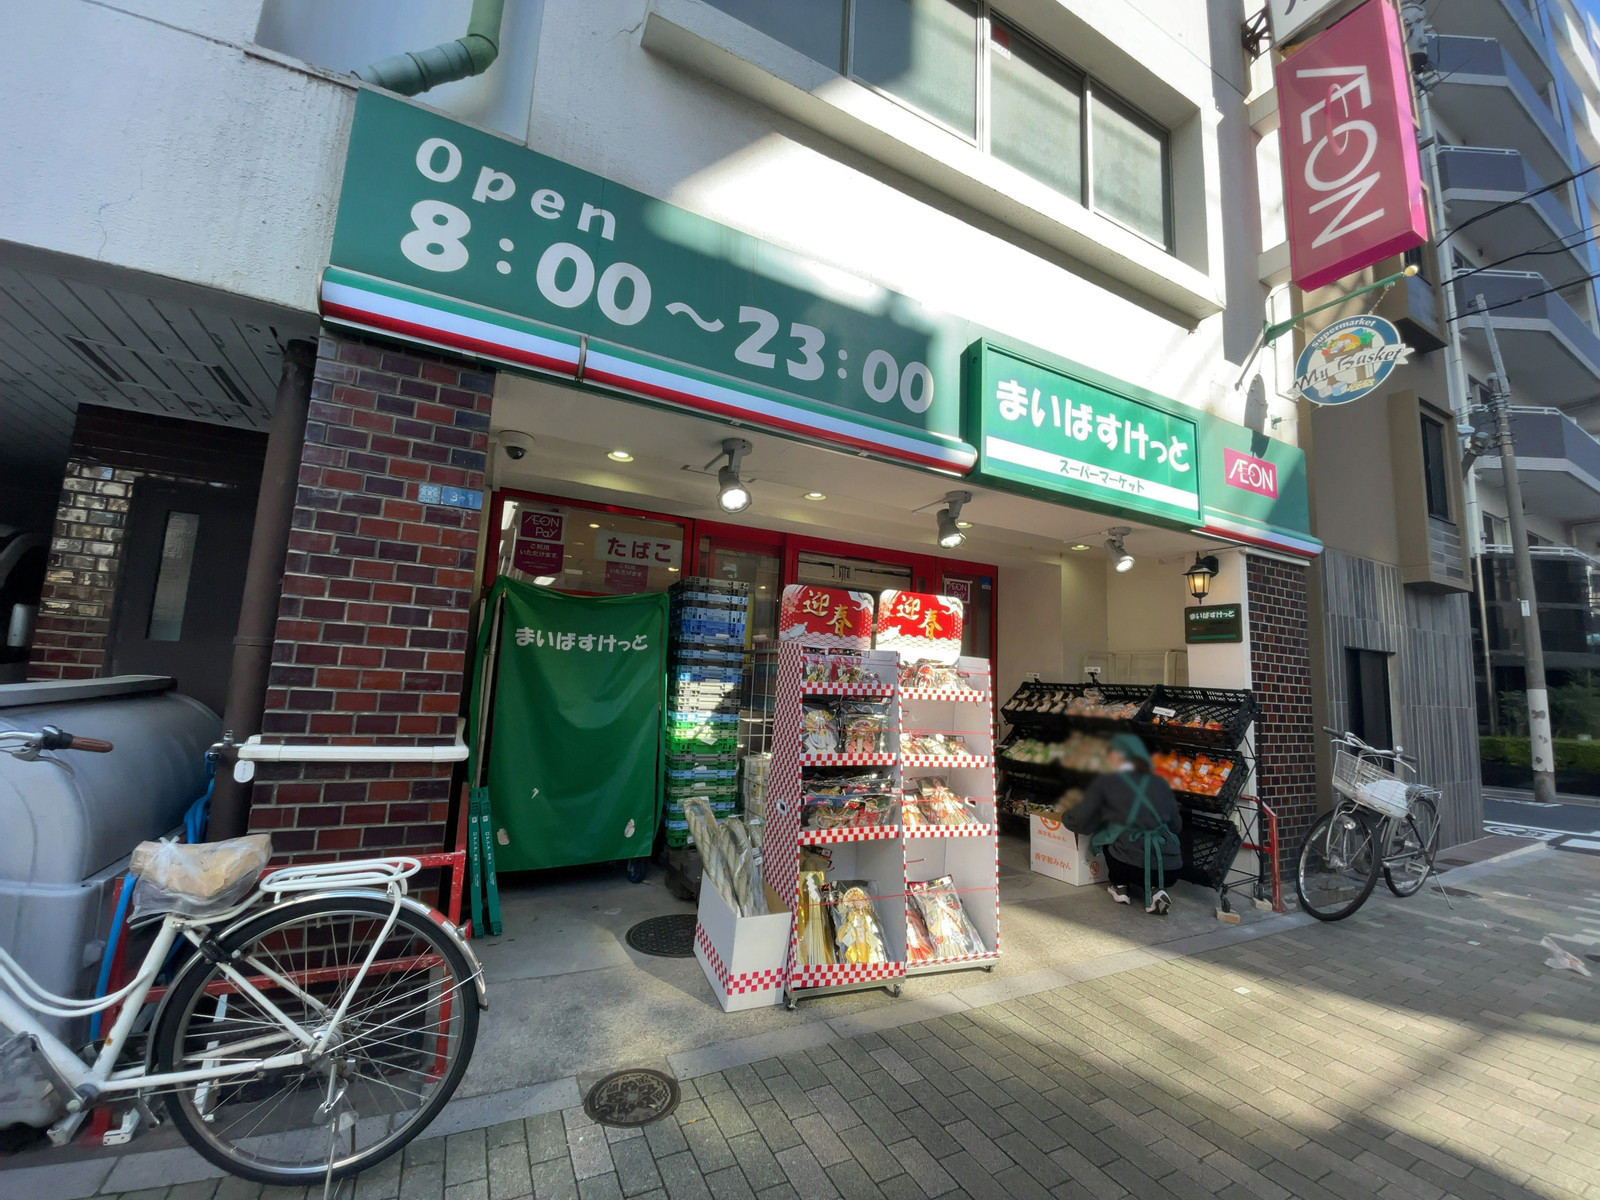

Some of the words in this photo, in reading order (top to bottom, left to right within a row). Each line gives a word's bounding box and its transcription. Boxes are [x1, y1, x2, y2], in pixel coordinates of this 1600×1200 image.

[415, 137, 617, 241] Open
[1311, 318, 1376, 348] Supermarket
[1293, 366, 1329, 390] My
[1337, 345, 1403, 370] Basket
[996, 380, 1191, 472] まいばすけっと
[1060, 459, 1145, 494] スーパーマーケット
[535, 526, 558, 538] Pay
[607, 537, 671, 563] たばこ
[802, 590, 853, 637] 迎春
[895, 594, 943, 639] 迎春
[1189, 610, 1235, 620] まいばすけっと
[515, 626, 648, 652] まいばすけっと
